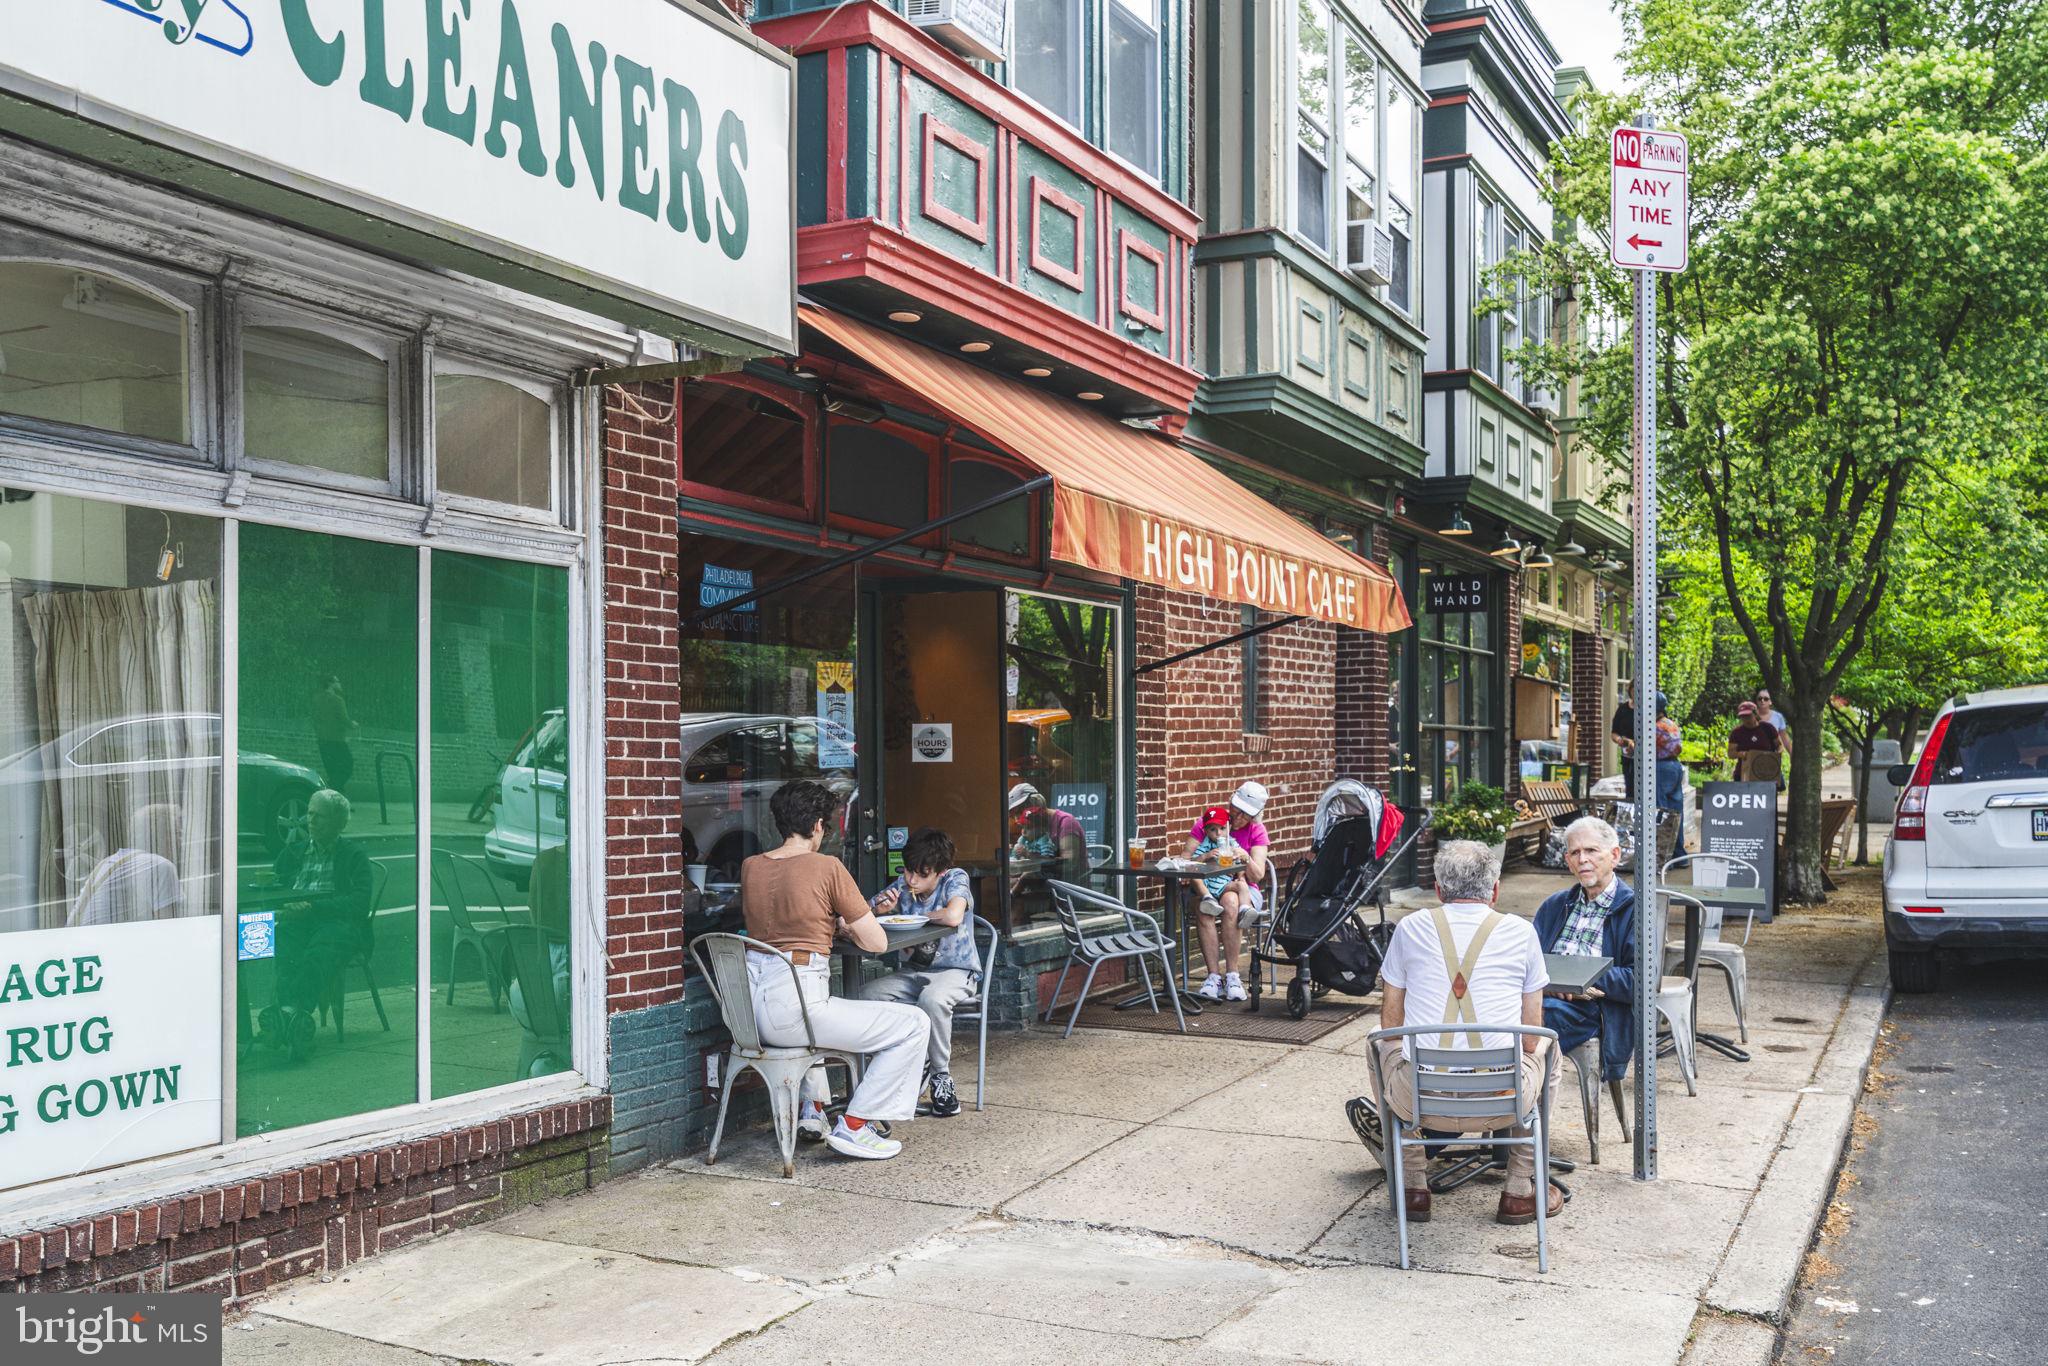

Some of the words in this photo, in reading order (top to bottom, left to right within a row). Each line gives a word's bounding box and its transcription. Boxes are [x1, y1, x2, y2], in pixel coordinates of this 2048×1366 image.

[1616, 134, 1639, 163] NO
[1643, 141, 1682, 164] PARKING
[1629, 178, 1671, 198] ANY
[1628, 205, 1672, 226] TIME
[705, 567, 752, 587] PHILADELPHIA
[1142, 519, 1214, 591] HIGH
[1225, 544, 1299, 608] POINT
[1307, 567, 1356, 622] CAFE
[1433, 580, 1481, 593] WILD
[701, 586, 755, 609] COMMUN
[1434, 594, 1481, 606] HAND
[917, 739, 947, 748] HOURS
[1711, 793, 1767, 809] OPEN
[6, 1016, 114, 1068] RUG
[37, 1064, 182, 1124] GOWN
